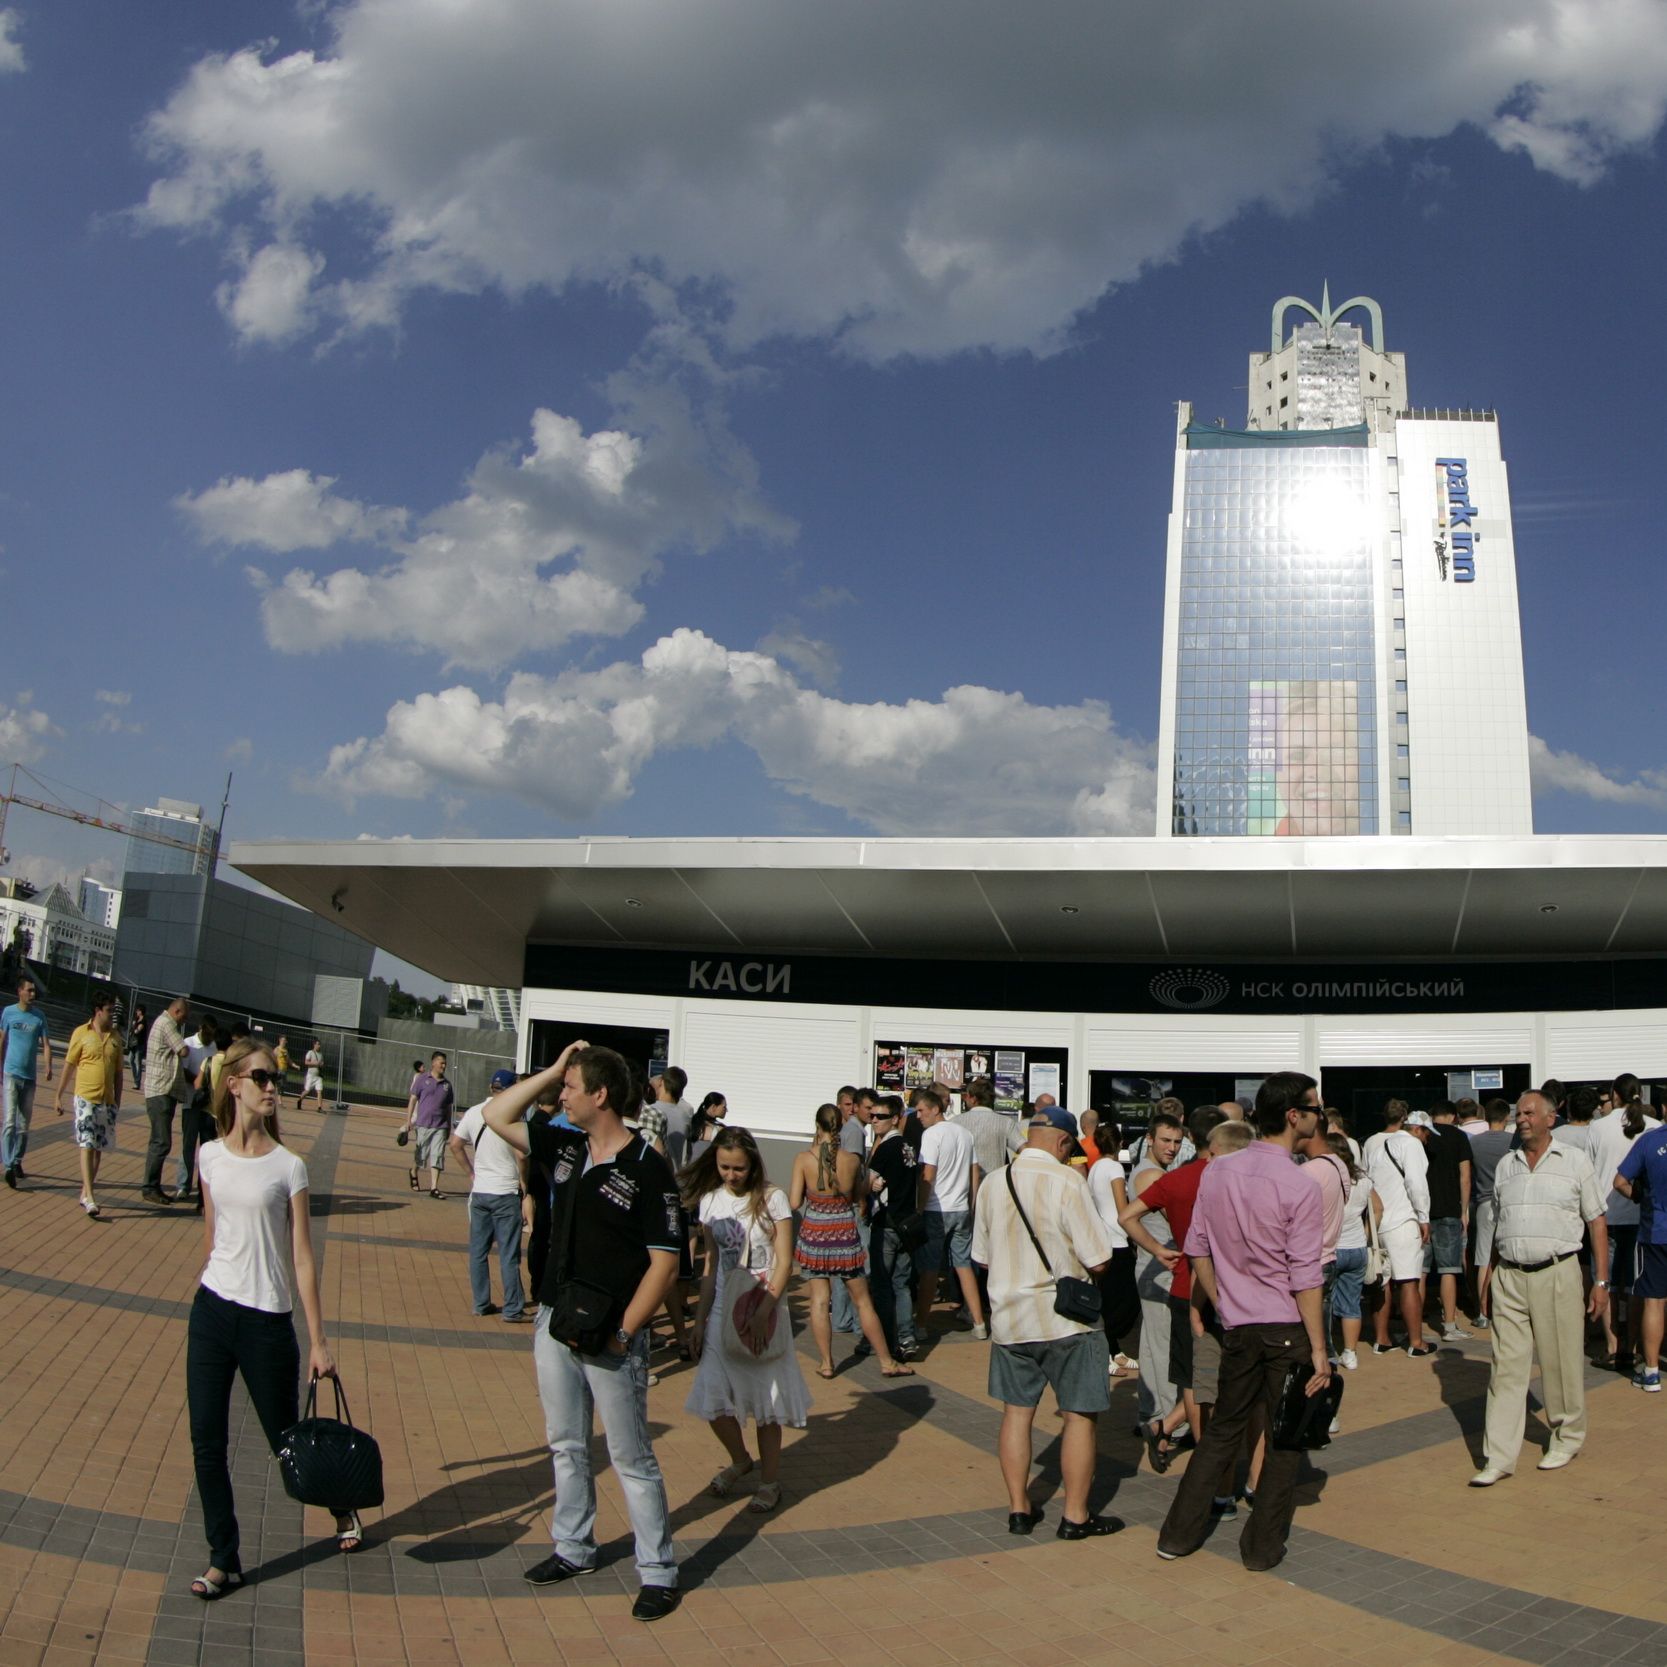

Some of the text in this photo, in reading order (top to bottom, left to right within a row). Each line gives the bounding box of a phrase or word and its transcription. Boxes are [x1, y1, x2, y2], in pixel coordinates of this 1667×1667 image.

[1435, 458, 1480, 583] park inn
[689, 960, 791, 993] КАСИ
[1242, 978, 1465, 998] НСК ОЛІМПІЙСЬКИЙ
